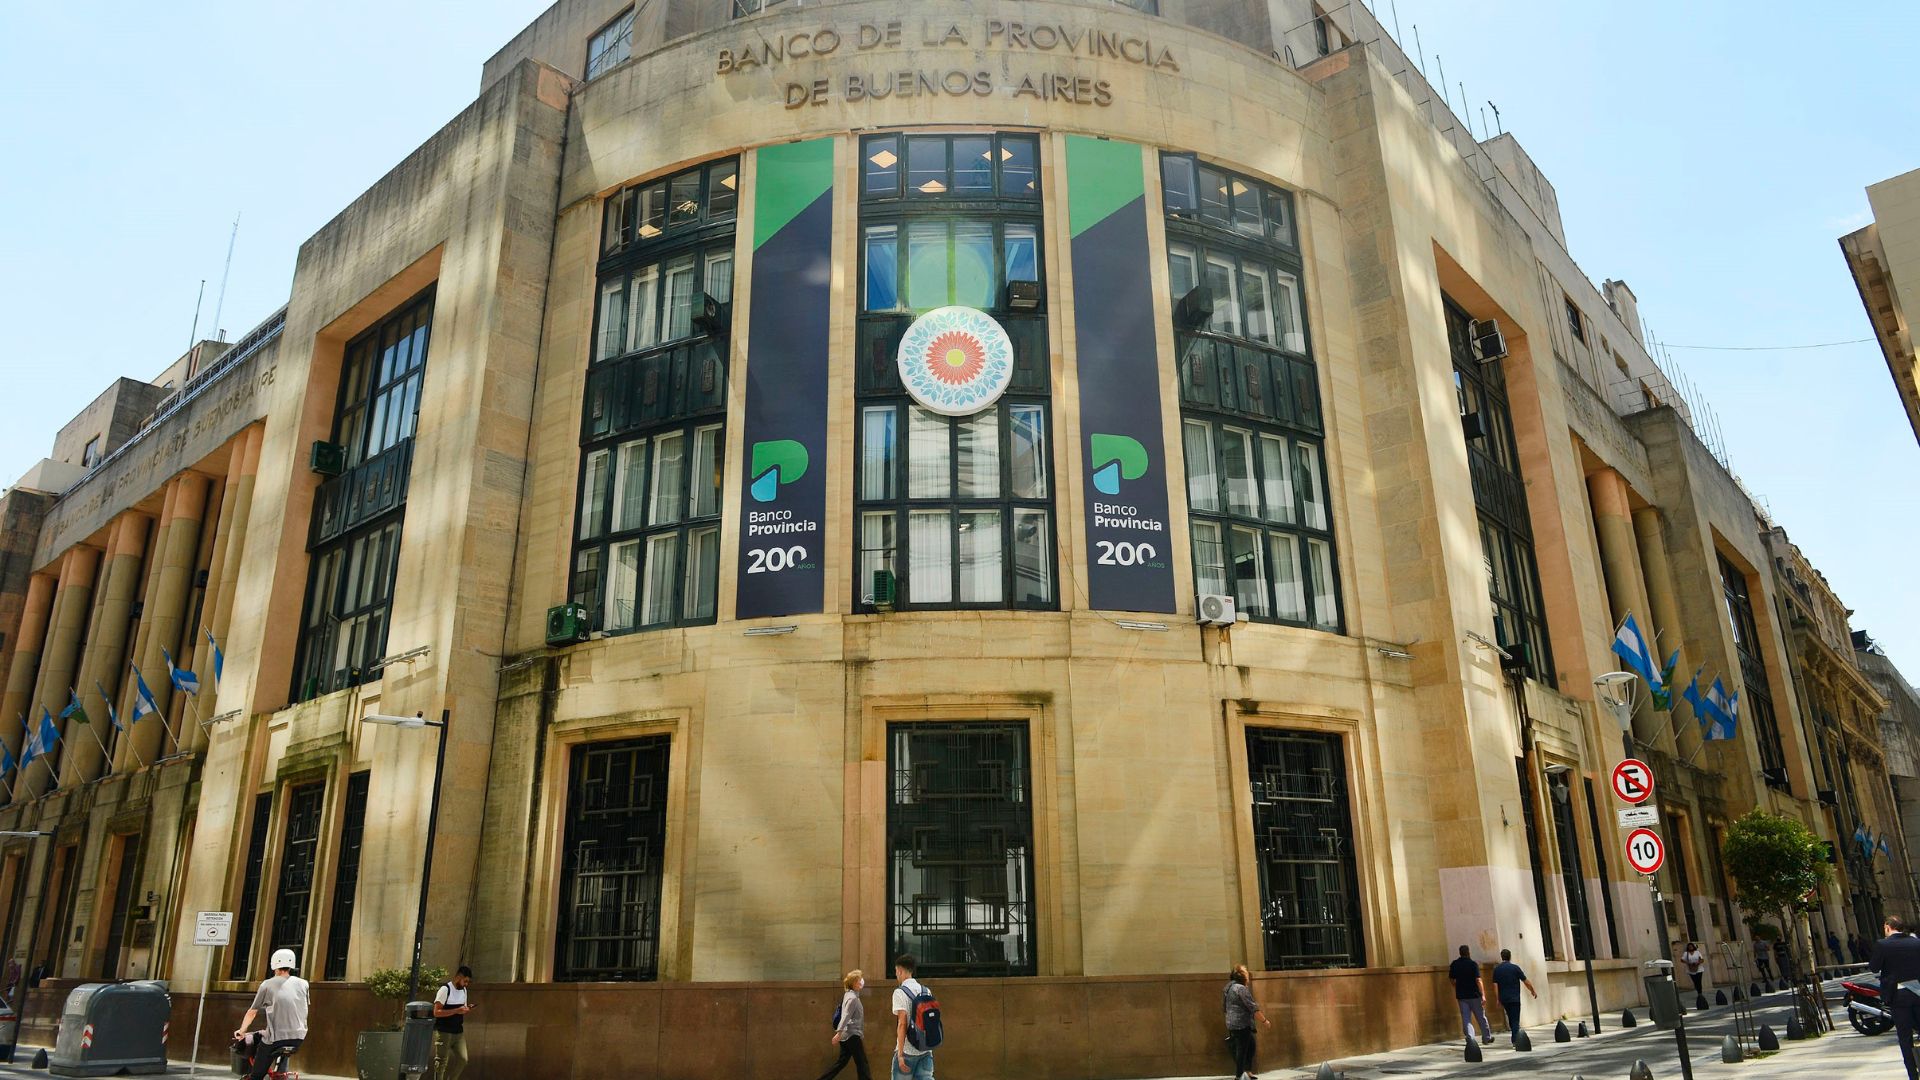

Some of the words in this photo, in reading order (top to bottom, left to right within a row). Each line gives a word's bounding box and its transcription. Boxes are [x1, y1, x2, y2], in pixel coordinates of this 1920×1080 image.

[716, 29, 840, 74] BANCO
[857, 22, 902, 50] DE
[923, 19, 968, 47] LA
[984, 19, 1180, 73] PROVINCIA
[784, 78, 829, 110] DE
[845, 69, 993, 103] BUENOS
[1012, 72, 1112, 107] AIRES
[246, 365, 277, 398] AIRE
[750, 510, 792, 522] Banco
[1094, 502, 1137, 516] Banco
[749, 520, 817, 536] Provincia
[1094, 515, 1162, 532] Provincia
[747, 545, 808, 574] 200
[1096, 540, 1157, 566] 200
[1633, 841, 1655, 860] 10
